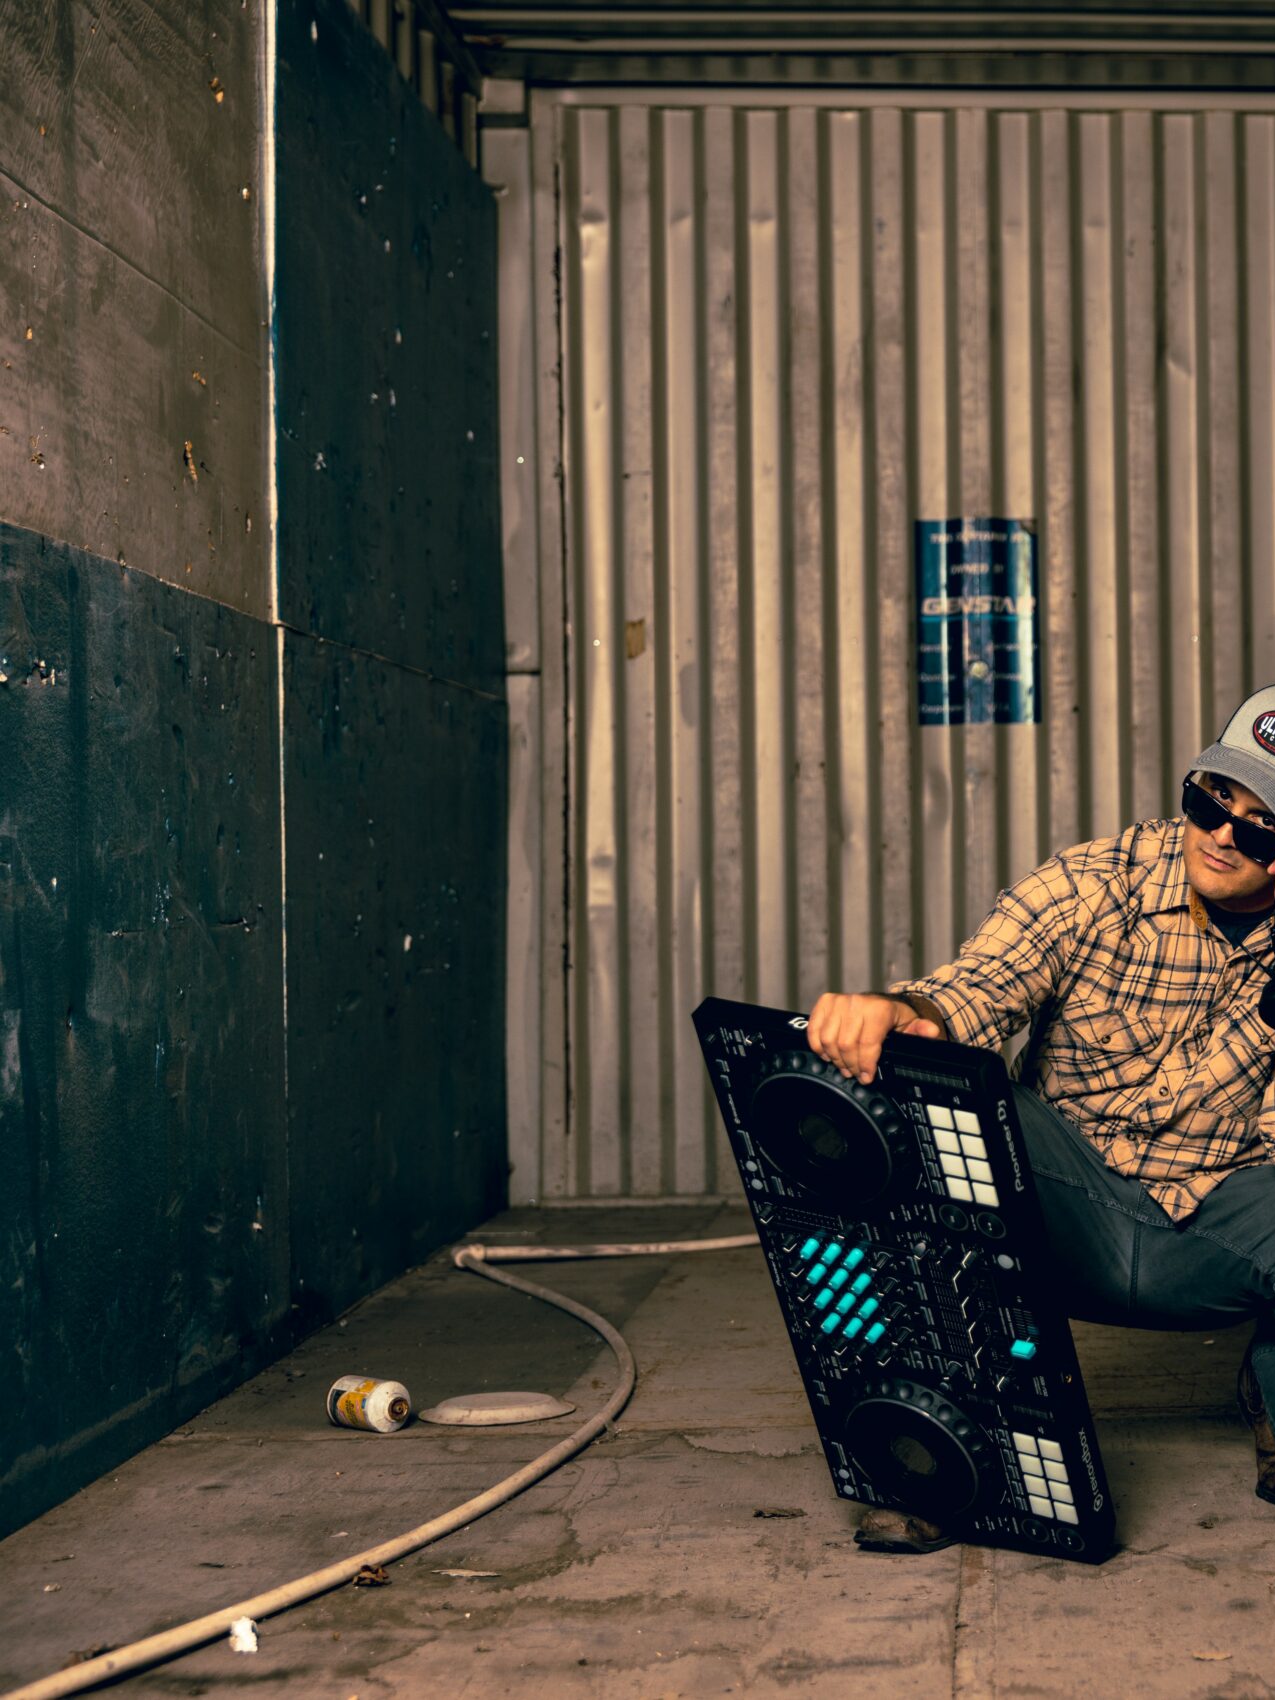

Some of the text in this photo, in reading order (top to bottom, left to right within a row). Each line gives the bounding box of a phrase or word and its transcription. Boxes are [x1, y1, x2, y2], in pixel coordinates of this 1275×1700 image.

[921, 596, 1036, 615] GENSTAR
[997, 1099, 1024, 1192] Pioneer DJ
[1078, 1427, 1099, 1496] rekordbox
